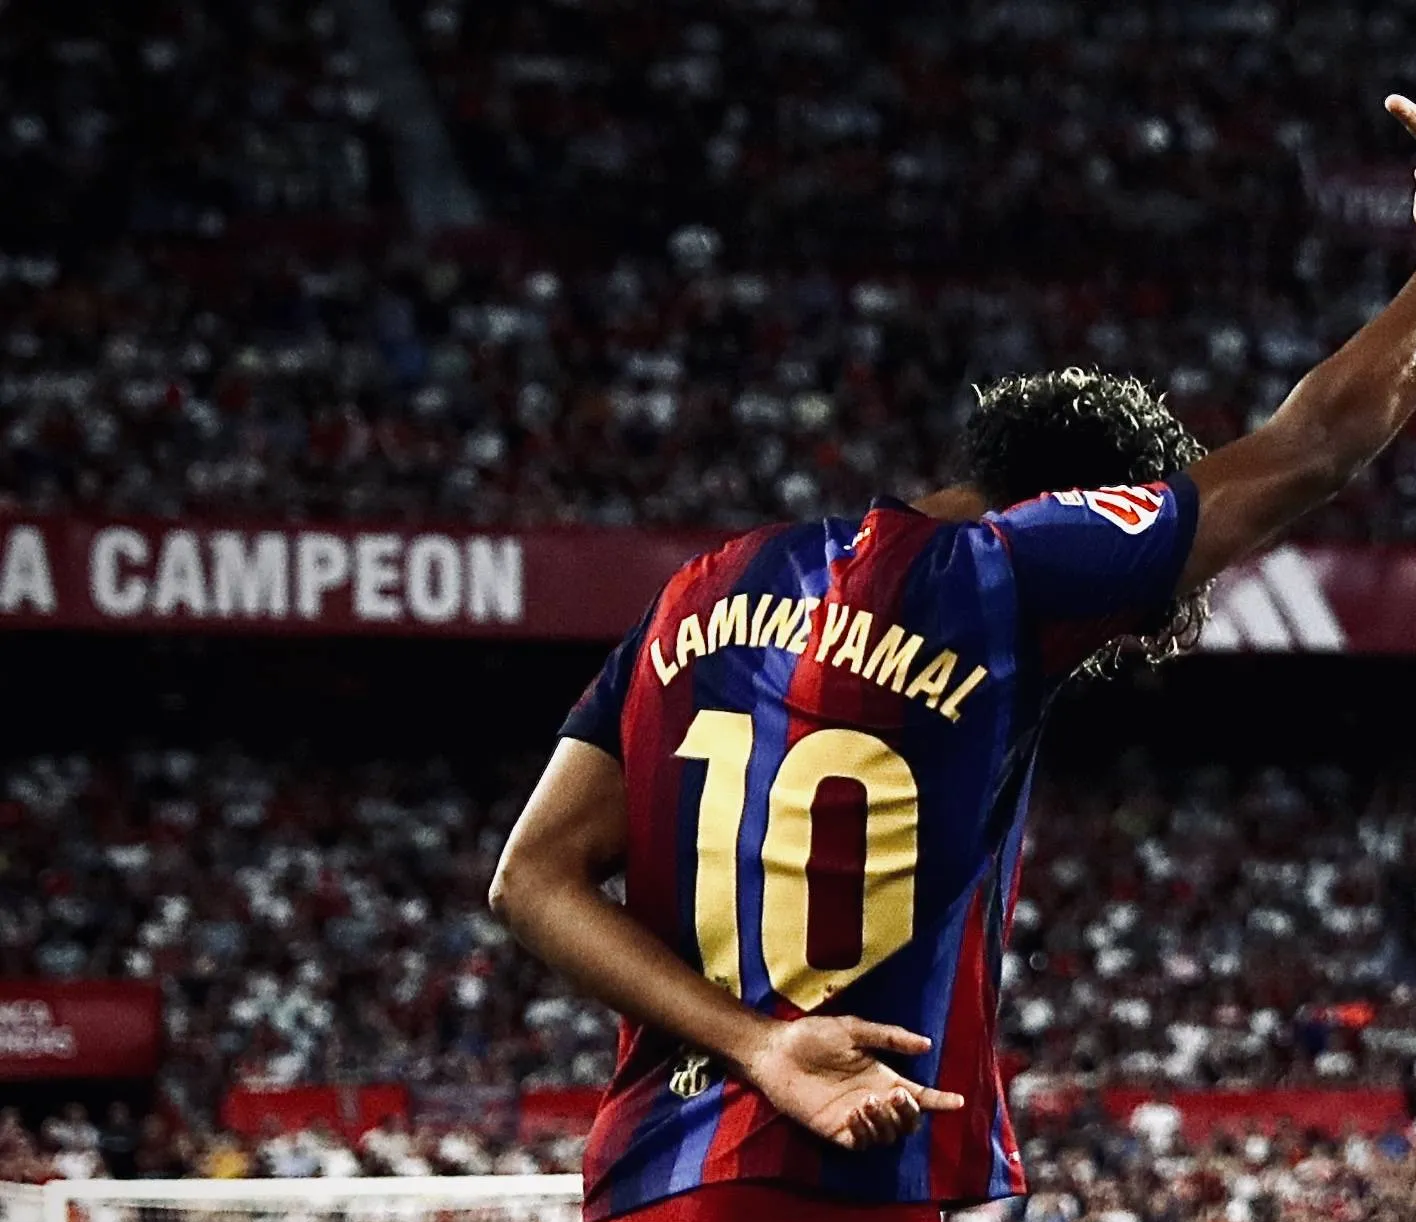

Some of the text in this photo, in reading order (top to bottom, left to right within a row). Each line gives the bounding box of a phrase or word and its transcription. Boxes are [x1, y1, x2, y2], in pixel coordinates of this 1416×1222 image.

[0, 525, 524, 624] A CAMPEON
[650, 594, 987, 723] LAMINE YAMAL
[674, 709, 918, 1011] 10
